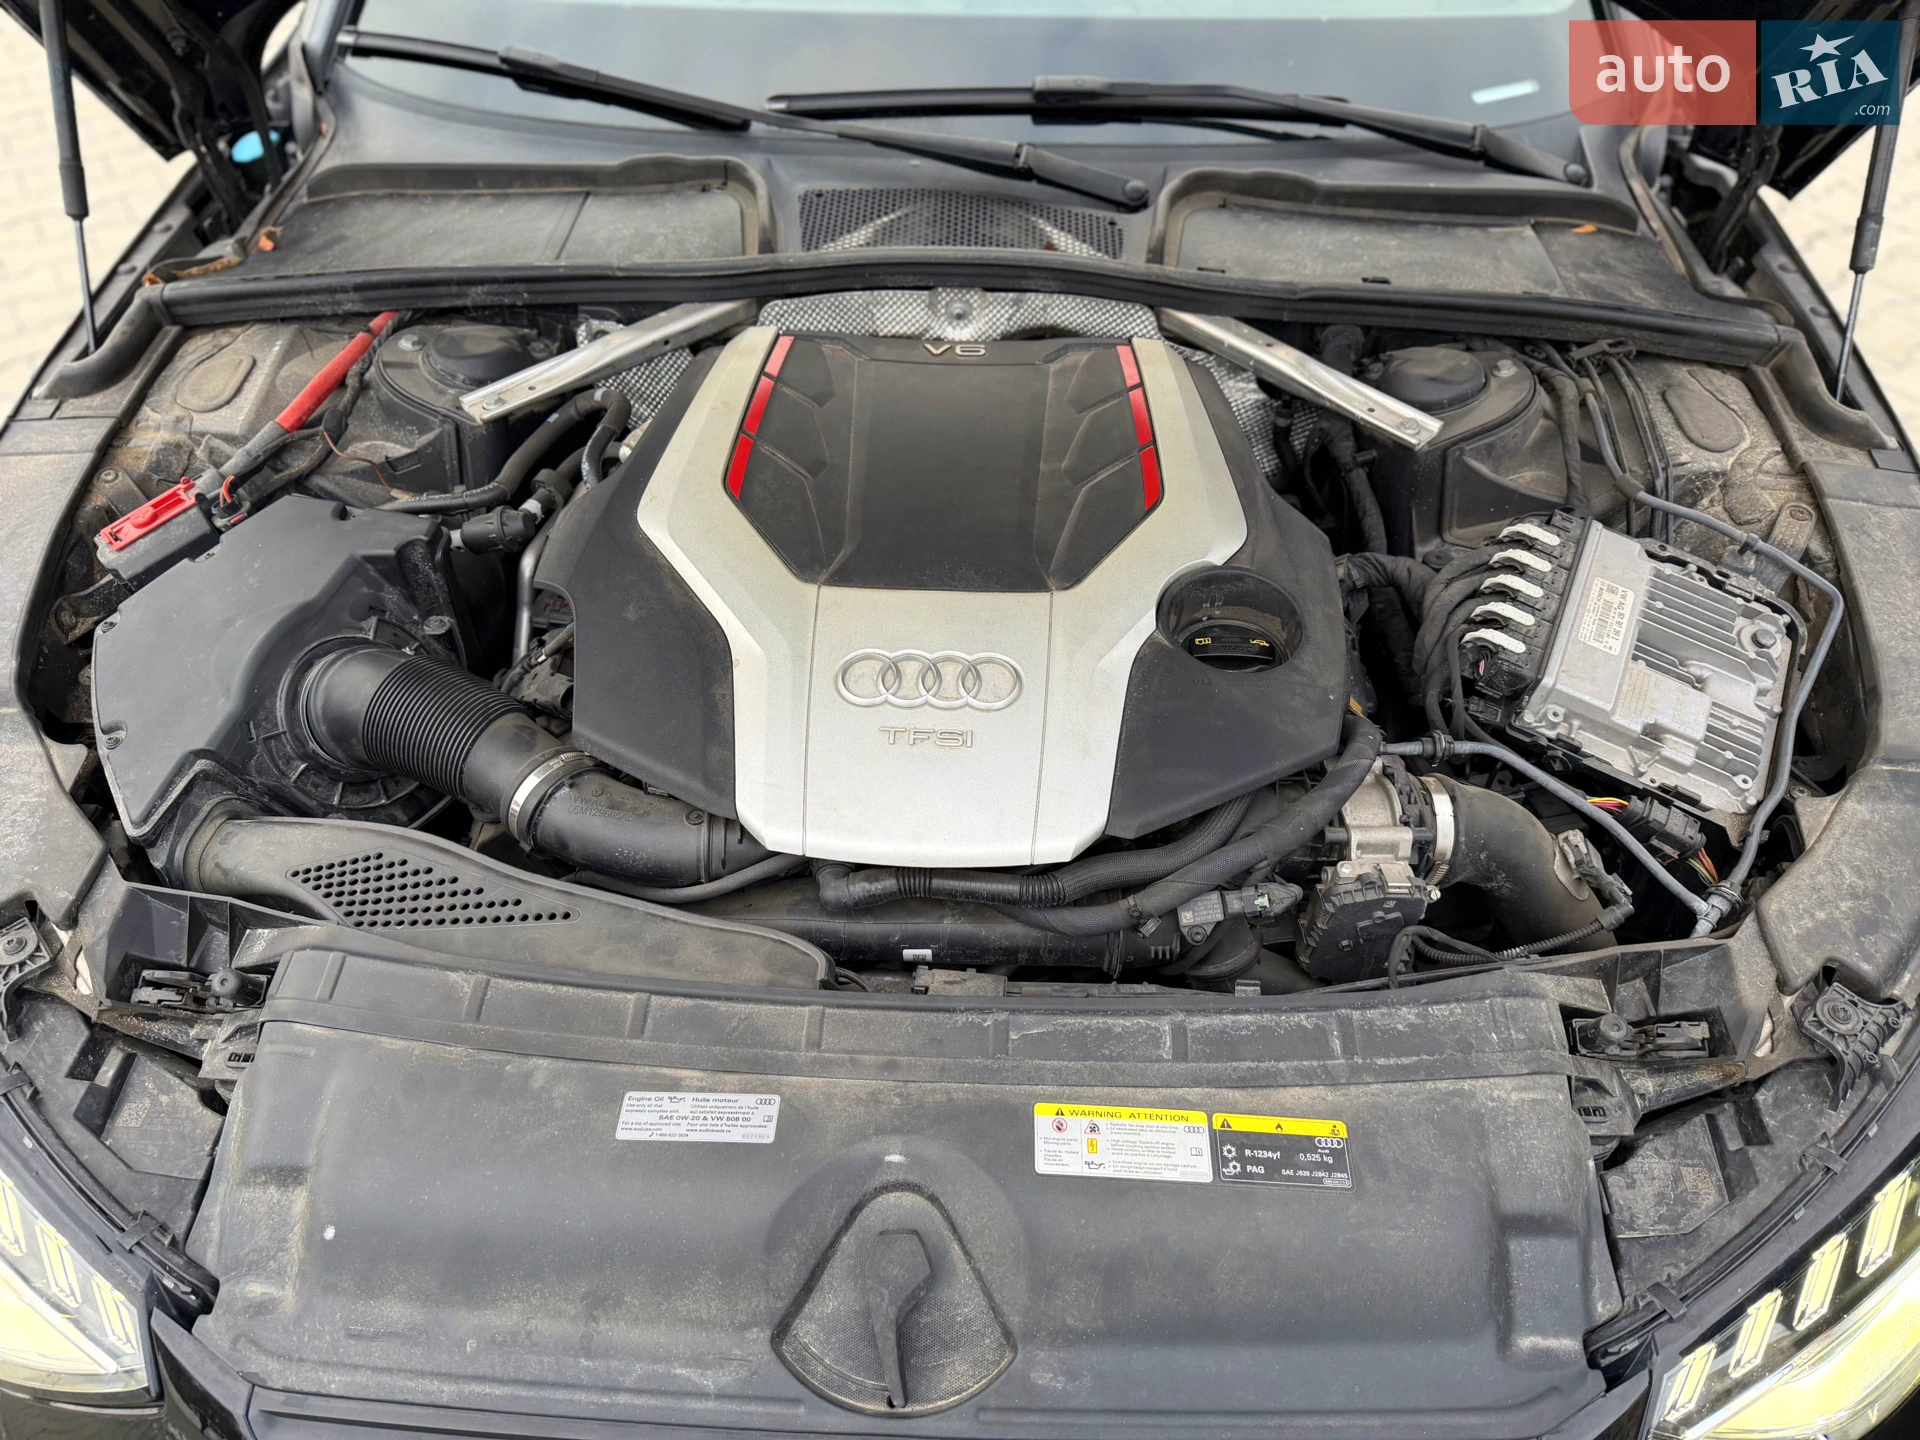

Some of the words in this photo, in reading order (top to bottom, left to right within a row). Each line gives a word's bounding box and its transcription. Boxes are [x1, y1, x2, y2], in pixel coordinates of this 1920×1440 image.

[922, 343, 986, 357] V6
[879, 726, 973, 747] TFSI
[1069, 1109, 1122, 1118] WARNING
[1129, 1113, 1189, 1122] ATTENTION
[1245, 1149, 1281, 1160] R-1234yf
[1299, 1153, 1321, 1162] 0,525
[1323, 1155, 1333, 1163] kg
[1247, 1165, 1265, 1174] PAG
